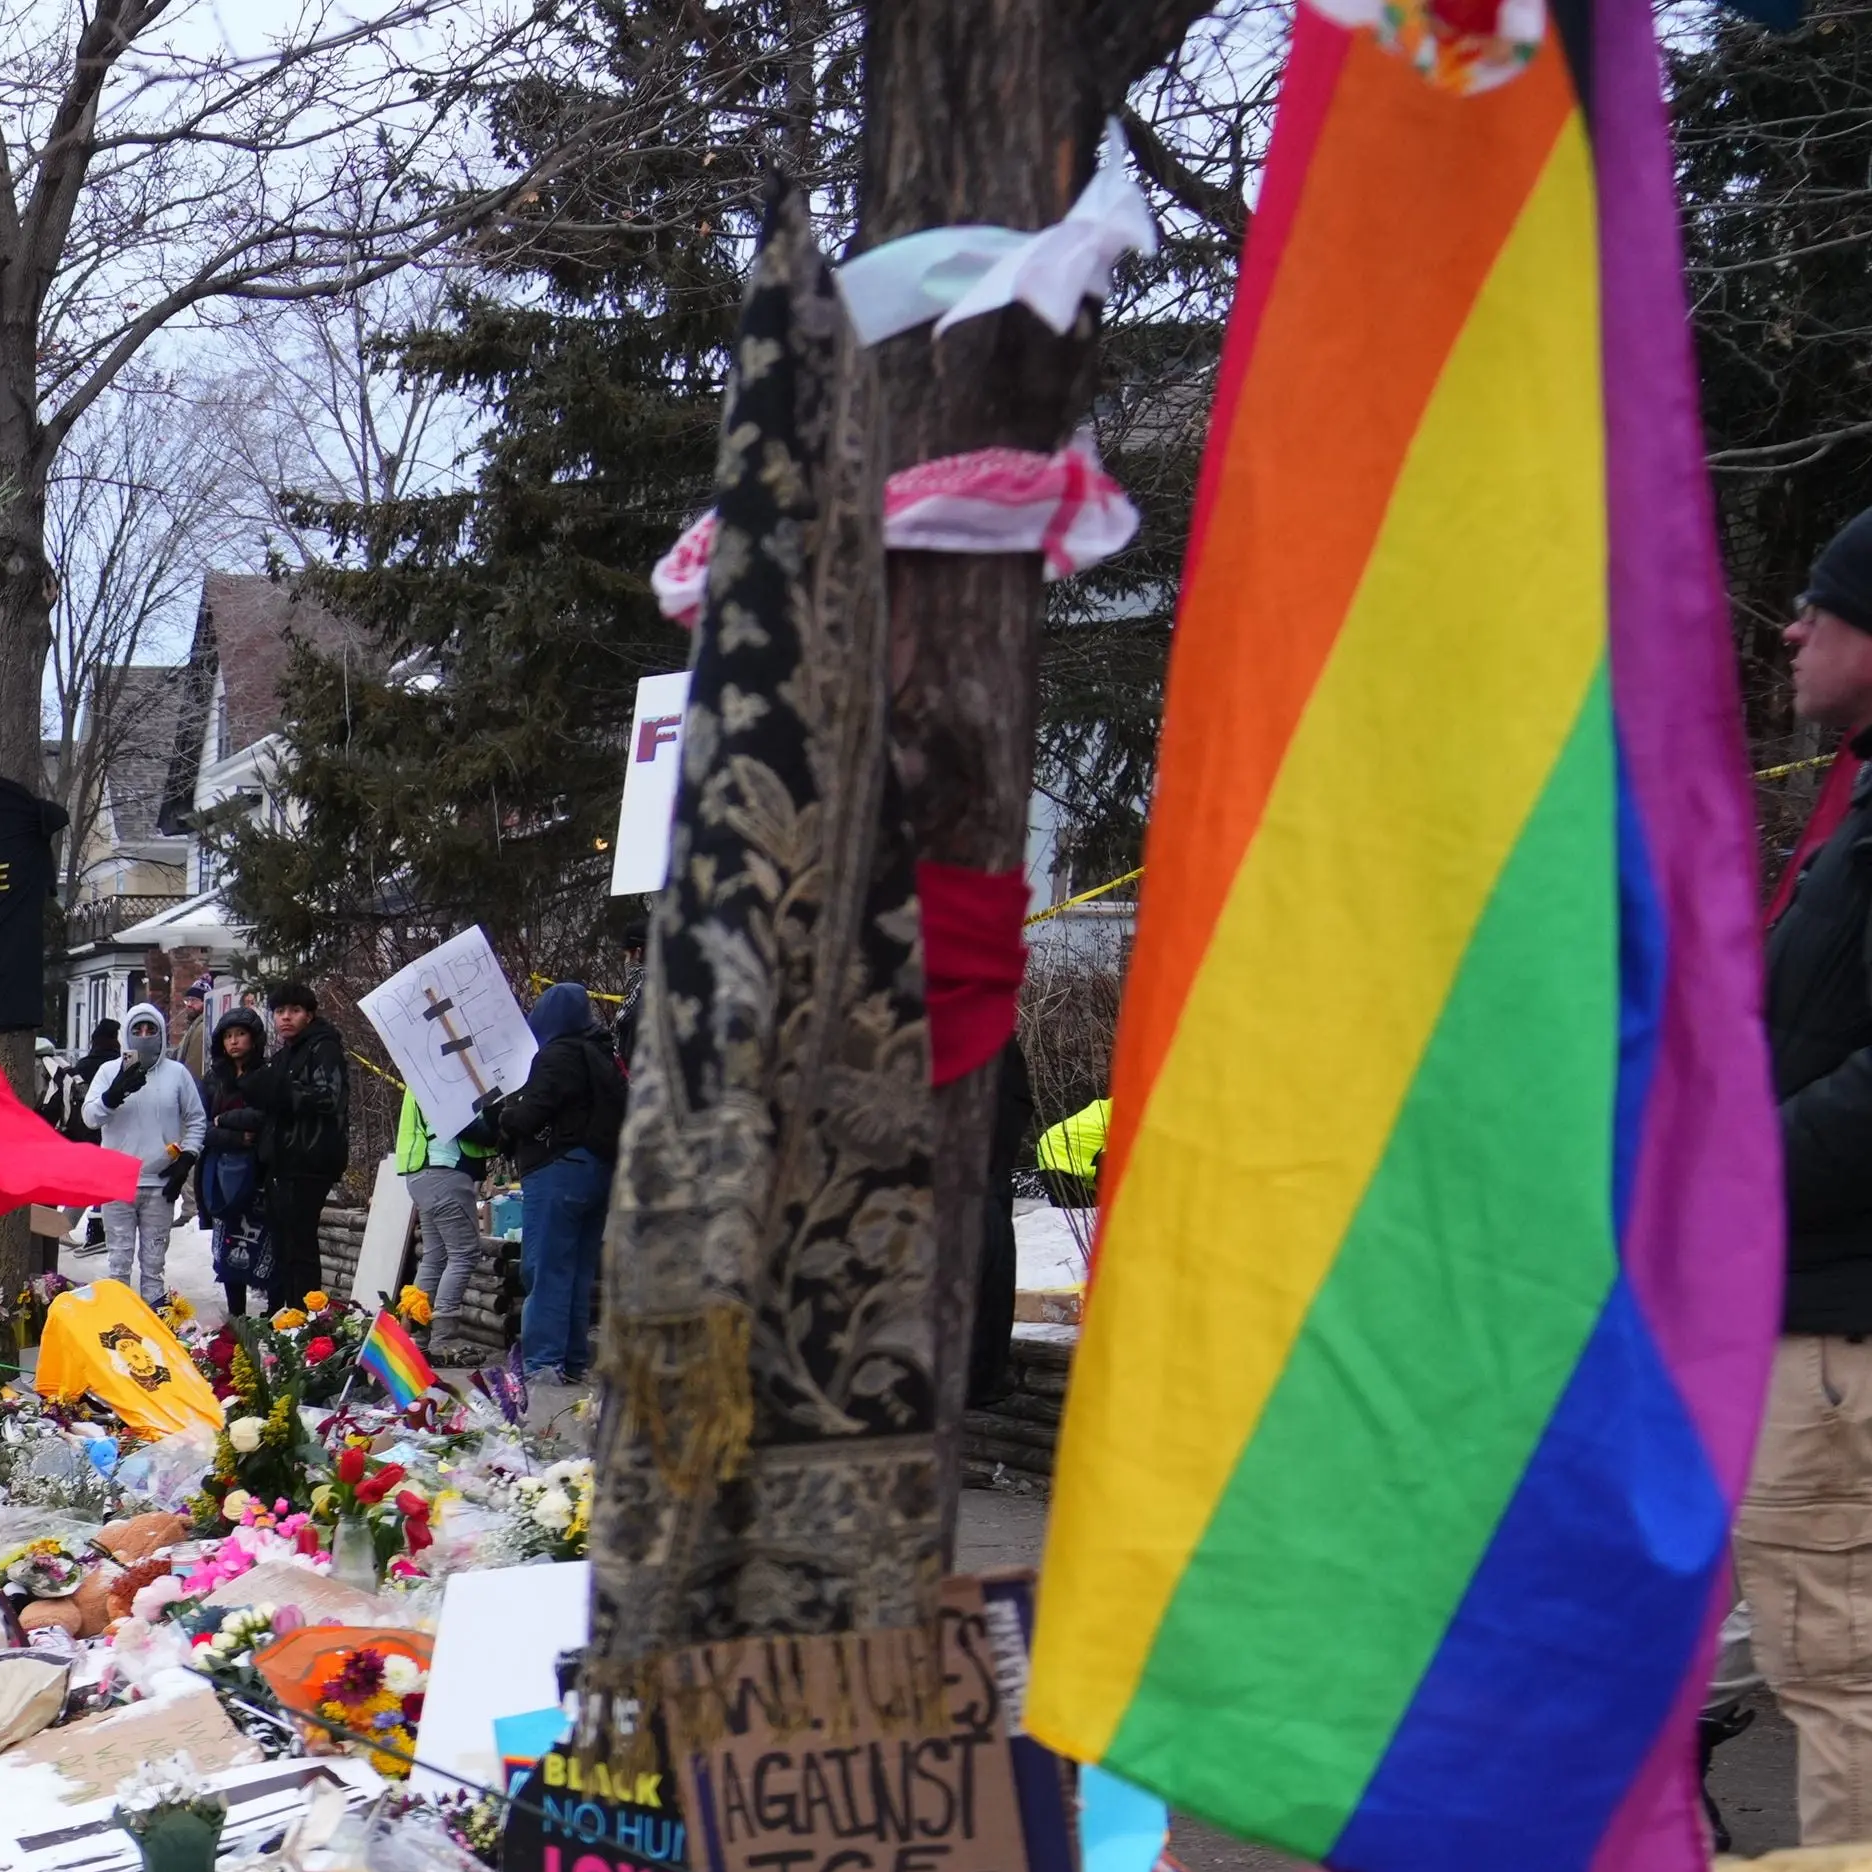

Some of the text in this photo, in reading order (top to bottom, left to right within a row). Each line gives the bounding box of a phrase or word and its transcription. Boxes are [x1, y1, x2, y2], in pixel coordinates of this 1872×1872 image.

[543, 1752, 664, 1809] BLACK
[722, 1732, 994, 1844] AGAINST
[542, 1794, 606, 1844] NO
